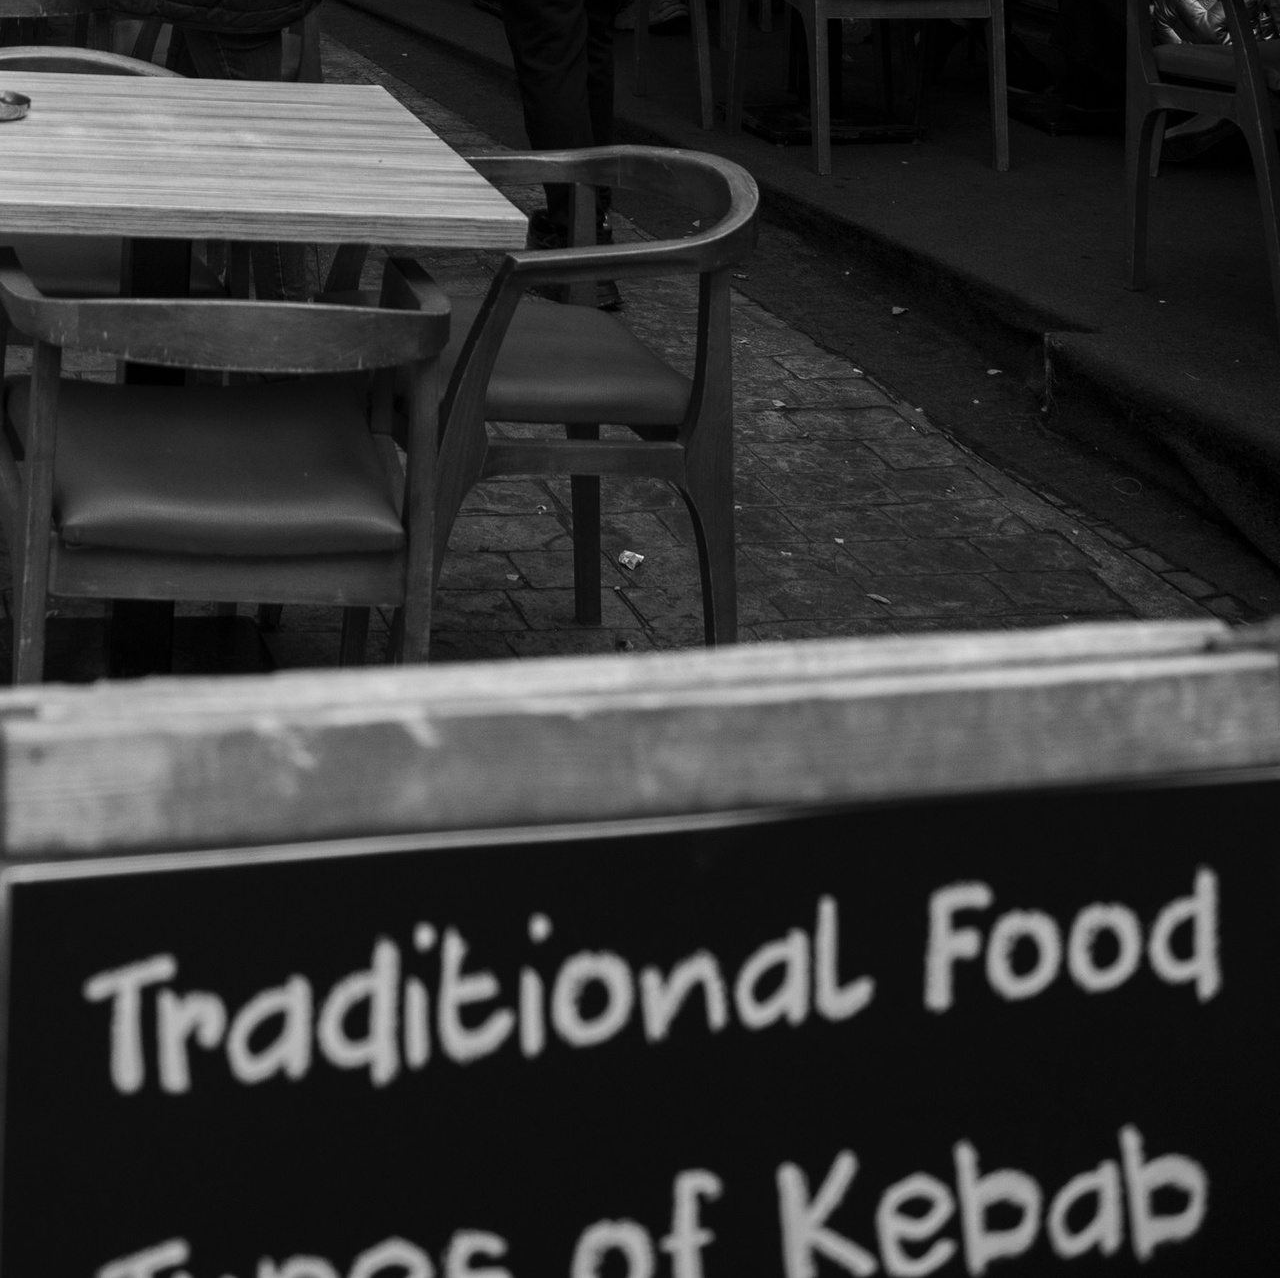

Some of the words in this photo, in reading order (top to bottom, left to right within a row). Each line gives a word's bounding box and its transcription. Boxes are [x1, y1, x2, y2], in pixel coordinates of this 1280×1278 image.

[85, 896, 873, 1094] Traditional
[925, 870, 1220, 1010] Food
[572, 1170, 721, 1278] of
[777, 1128, 1207, 1278] Kebab
